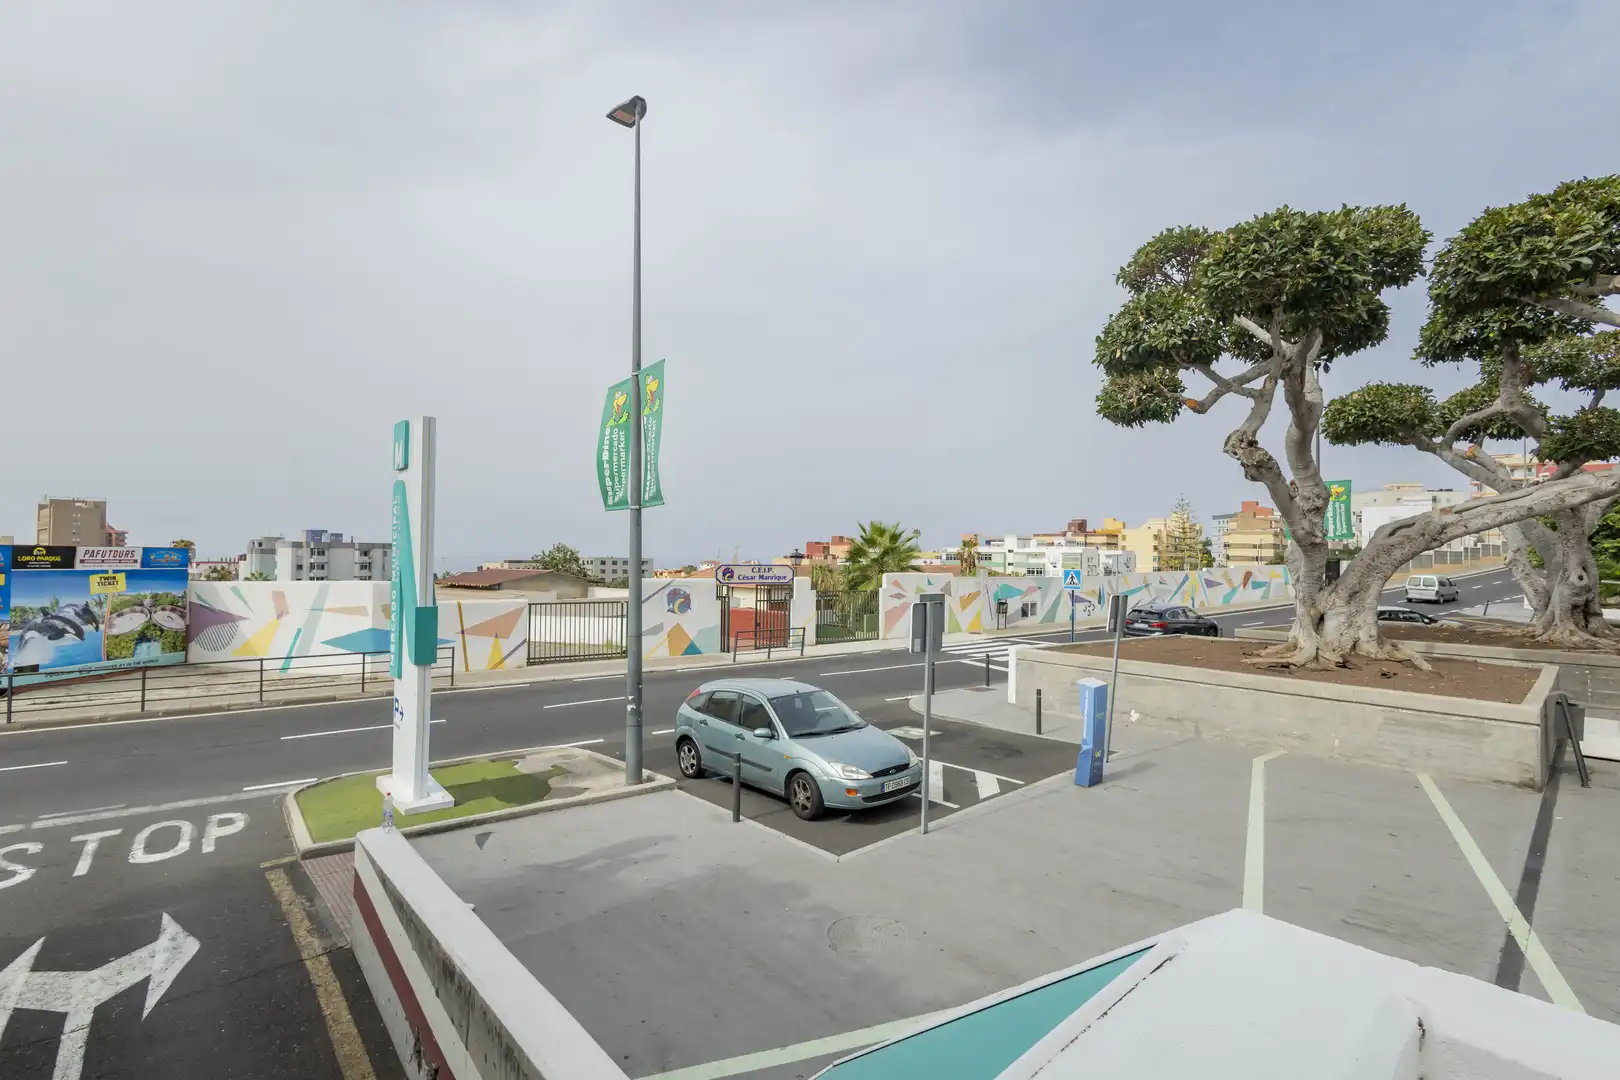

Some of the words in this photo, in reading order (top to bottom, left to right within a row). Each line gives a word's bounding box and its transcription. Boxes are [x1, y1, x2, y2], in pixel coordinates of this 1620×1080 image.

[612, 428, 621, 502] Supermercado
[83, 549, 136, 559] PAFUTOURS
[0, 812, 248, 889] STOP
